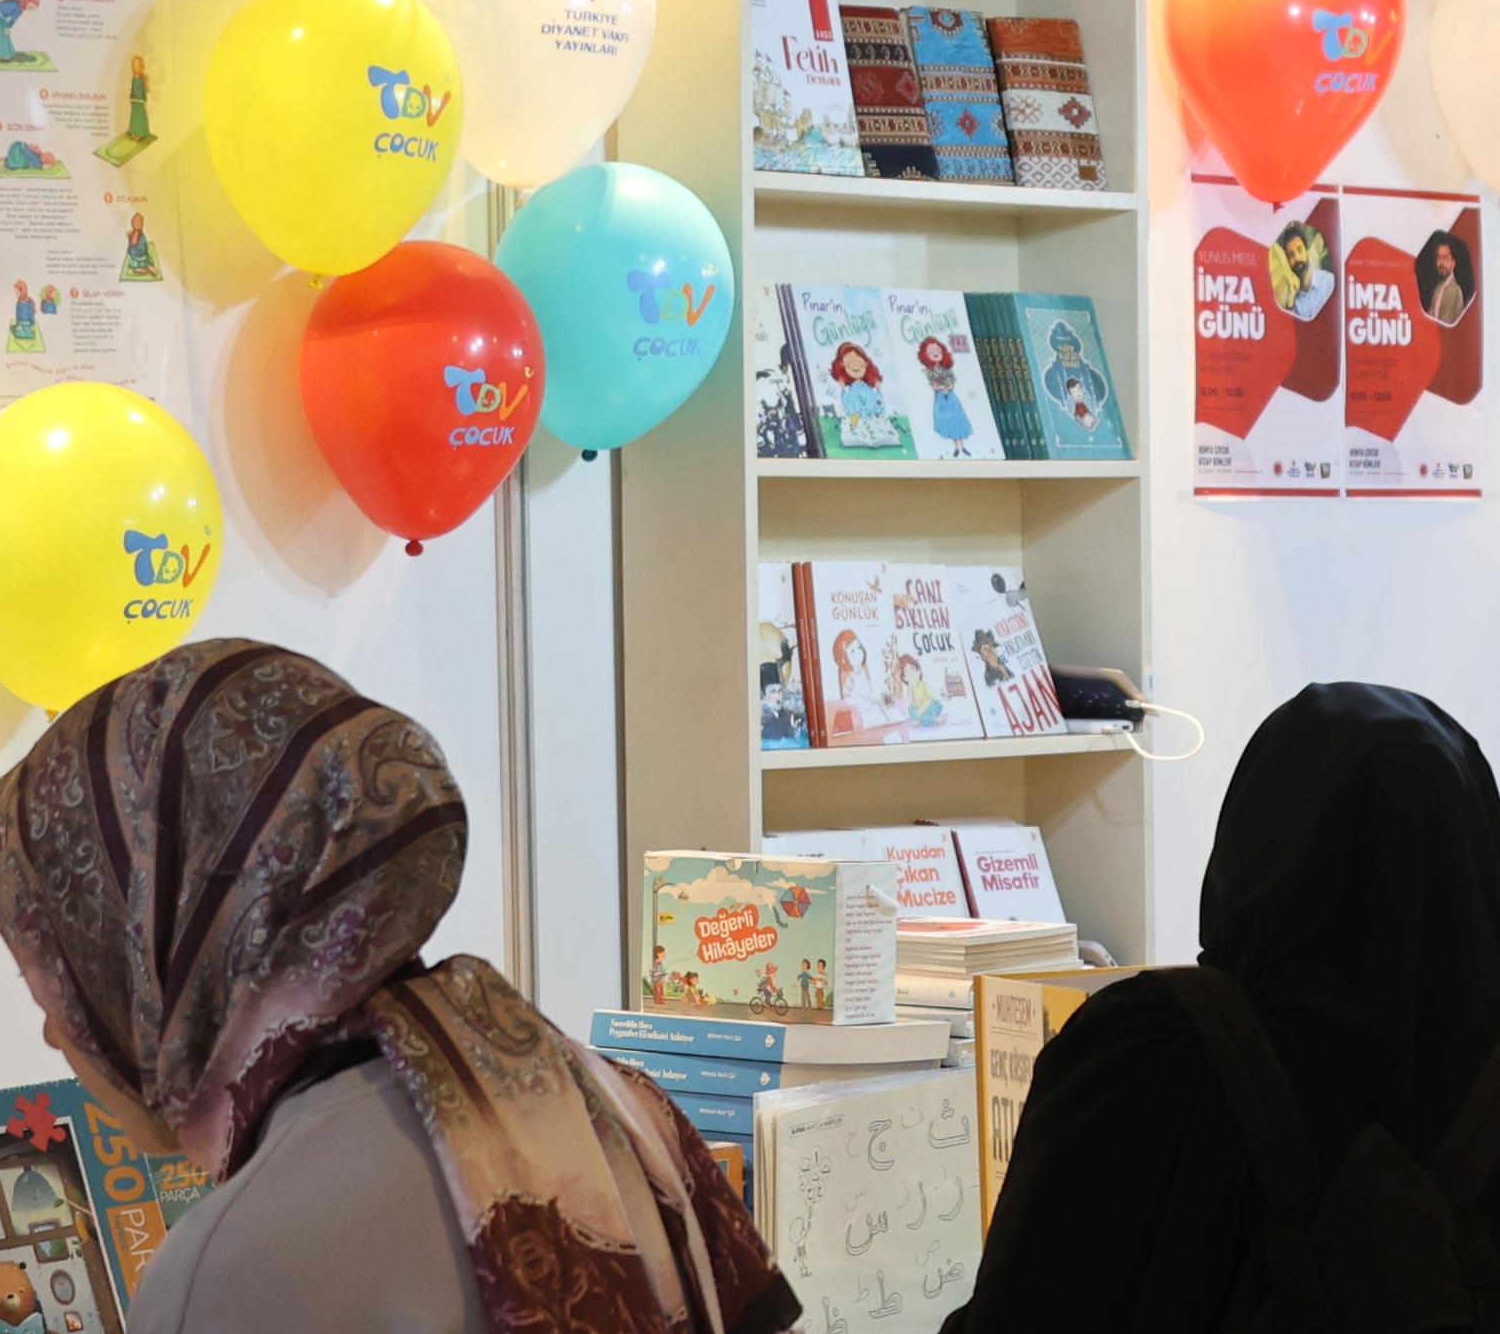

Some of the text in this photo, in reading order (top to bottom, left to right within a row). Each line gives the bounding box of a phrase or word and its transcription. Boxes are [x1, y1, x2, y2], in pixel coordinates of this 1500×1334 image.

[541, 19, 600, 38] DİYANET
[554, 39, 618, 57] YAYINLARI
[781, 34, 840, 74] Fetih
[367, 64, 451, 128] TDV
[1314, 72, 1377, 98] ÇOCUK
[374, 131, 438, 162] ÇOCUK
[627, 268, 717, 326] TDV
[1198, 266, 1256, 304] İMZA
[1349, 274, 1403, 311] İMZA
[801, 292, 844, 314] Pınar'ın
[888, 294, 929, 315] Pınar'ın
[812, 309, 879, 348] Günlüğü
[900, 309, 960, 346] Günlüğü
[1198, 305, 1265, 340] GÜNÜ
[1350, 312, 1412, 346] GÜNÜ
[632, 335, 701, 362] ÇOCUK
[444, 365, 529, 421] TDV
[448, 424, 515, 451] ÇOCUK
[123, 528, 212, 589] TDV
[123, 597, 196, 626] ÇOCUK
[830, 589, 879, 605] KONUŞAN
[832, 605, 880, 622] GÜNLÜK
[912, 631, 956, 657] ÇOCUK
[996, 663, 1063, 737] AJAN
[885, 845, 946, 864] Kuyudan
[976, 853, 1040, 874] Gizemli
[981, 873, 1041, 893] Misafir
[897, 889, 958, 908] Mucize
[698, 909, 755, 940] Değerli
[702, 931, 776, 963] Hikâyeler
[83, 1102, 154, 1273] 250 PAR
[160, 1161, 210, 1191] 250
[159, 1186, 201, 1205] PARÇA
